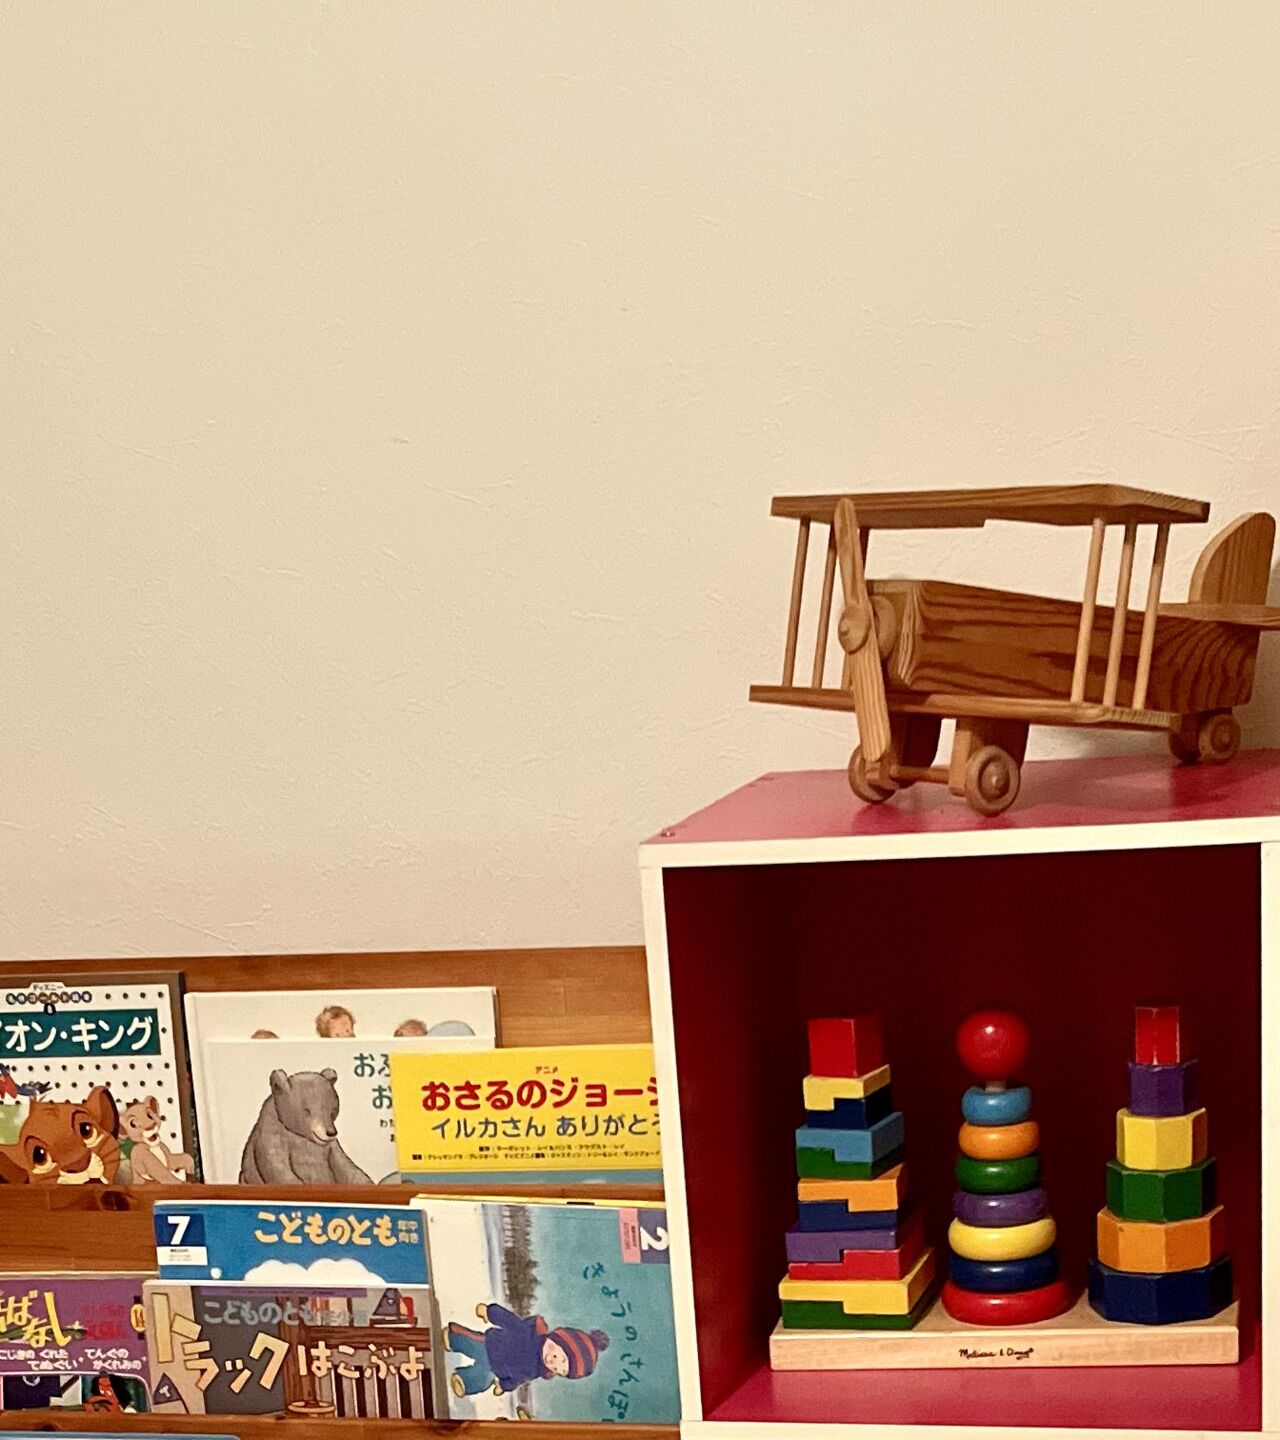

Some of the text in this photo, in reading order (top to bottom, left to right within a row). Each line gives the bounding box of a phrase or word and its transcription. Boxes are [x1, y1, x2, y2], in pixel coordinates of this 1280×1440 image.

[432, 1116, 546, 1140] イルカさん
[167, 1215, 191, 1245] 7
[255, 1211, 397, 1247] こどものとも
[640, 1226, 669, 1251] 2
[204, 1301, 318, 1326] こどものとも
[583, 1262, 644, 1422] きょうのさんぽ
[297, 1340, 425, 1381] はこぶよ
